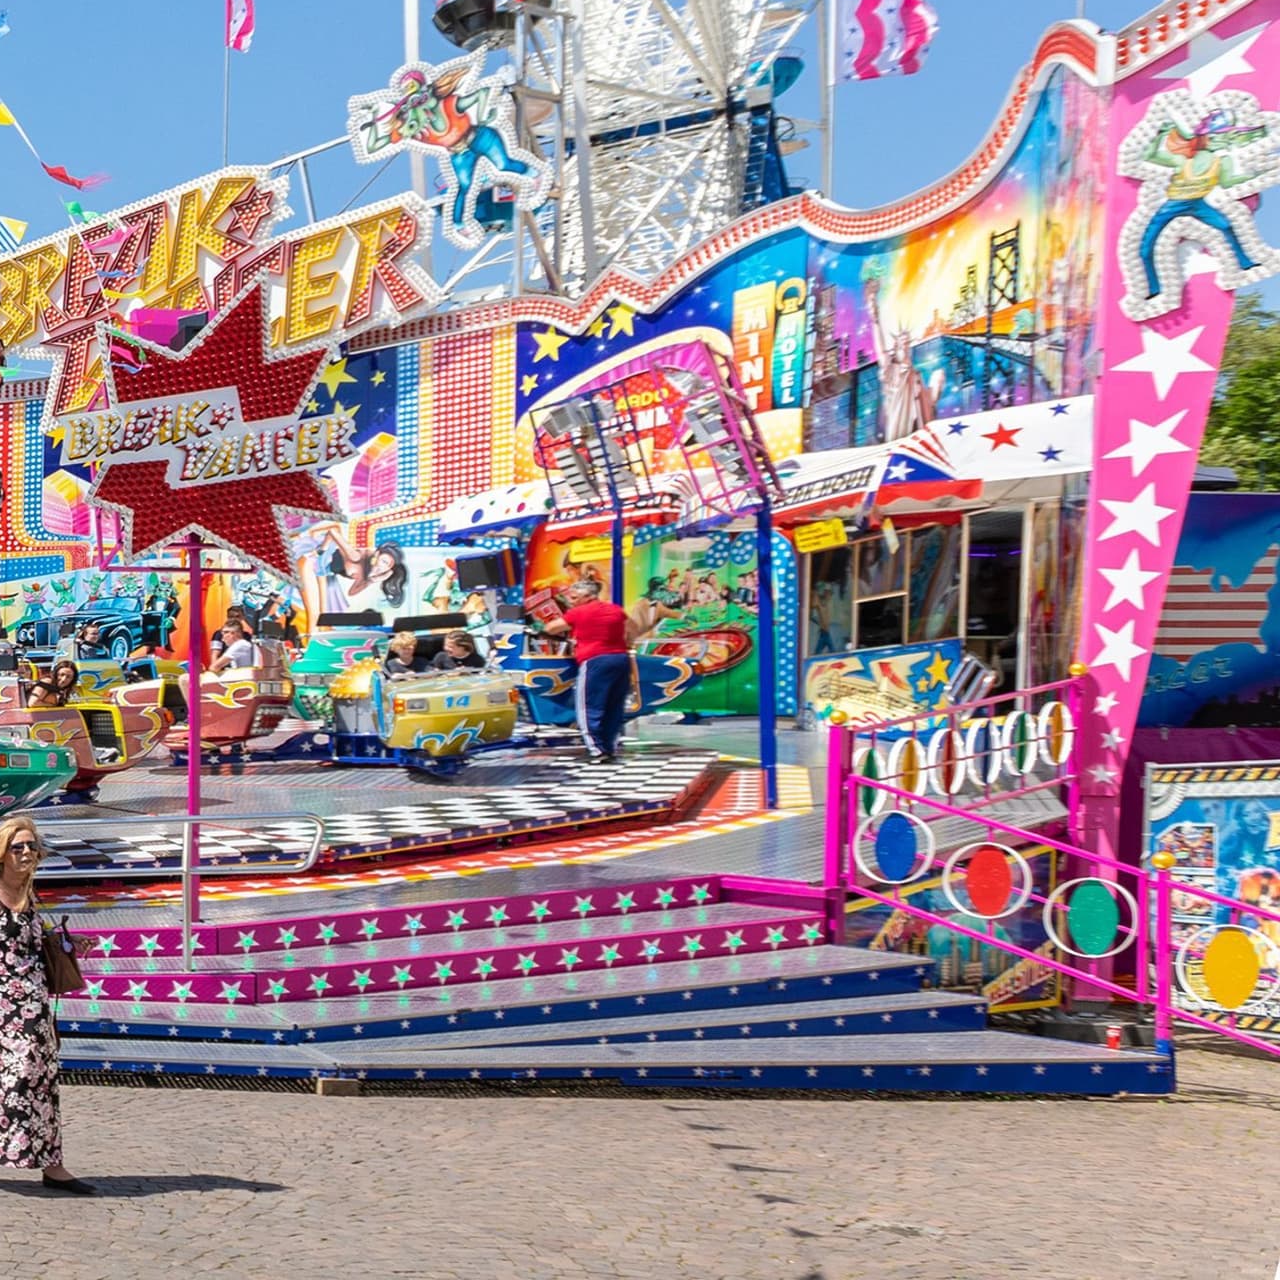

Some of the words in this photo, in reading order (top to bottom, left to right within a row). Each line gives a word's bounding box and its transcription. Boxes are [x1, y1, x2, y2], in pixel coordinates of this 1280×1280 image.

[740, 305, 769, 411] MINT
[780, 318, 798, 405] HOTEL
[68, 398, 211, 461] BREAK
[174, 416, 358, 481] DANCER
[445, 694, 470, 709] 14
[47, 752, 57, 768] 2
